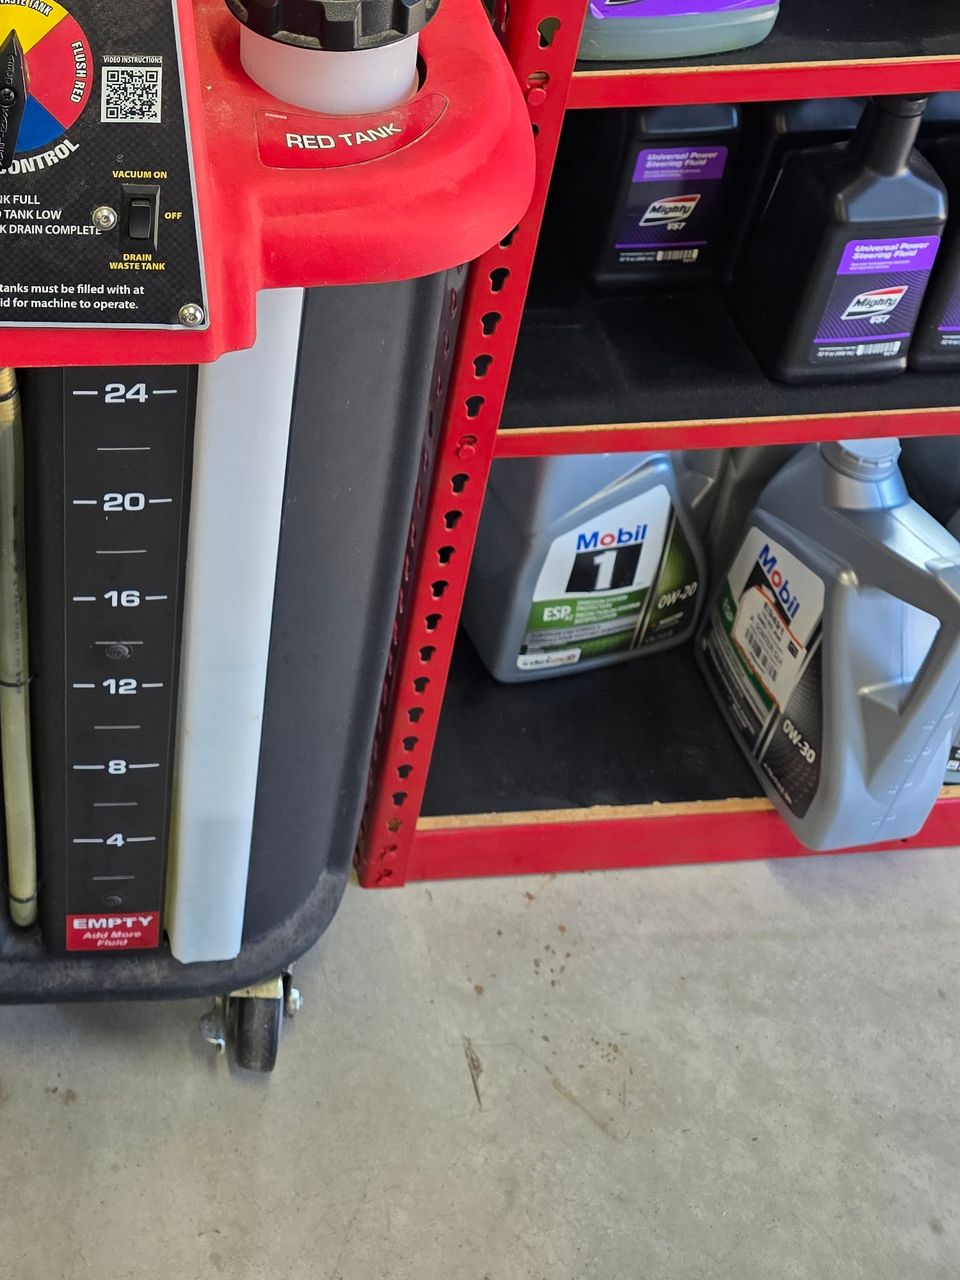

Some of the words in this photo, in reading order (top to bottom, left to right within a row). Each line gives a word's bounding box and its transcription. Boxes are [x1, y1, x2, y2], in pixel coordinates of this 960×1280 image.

[71, 41, 87, 77] FLUSH
[70, 80, 86, 103] RED
[286, 133, 335, 149] RED
[339, 123, 402, 146] TANK
[13, 195, 40, 204] FULL
[4, 210, 34, 219] TANK
[36, 210, 61, 220] LOW
[9, 225, 42, 234] DRAIN
[45, 225, 101, 235] COMPLETE
[0, 283, 28, 293] tanks
[31, 285, 58, 293] must
[61, 284, 74, 293] be
[77, 284, 104, 294] filled
[107, 284, 130, 294] with
[133, 286, 144, 295] at
[13, 298, 28, 307] for
[31, 298, 77, 308] machine
[80, 299, 90, 308] to
[93, 300, 138, 310] operate.
[104, 383, 148, 404] 24
[103, 492, 145, 511] 20
[576, 524, 648, 551] Mobil
[593, 550, 618, 590] 1
[758, 543, 800, 619] Mobil
[103, 590, 140, 607] 16
[102, 679, 138, 695] 12
[782, 719, 816, 764] 0W-30
[107, 759, 127, 774] 8
[105, 833, 125, 847] 4
[73, 916, 154, 929] EMPTY
